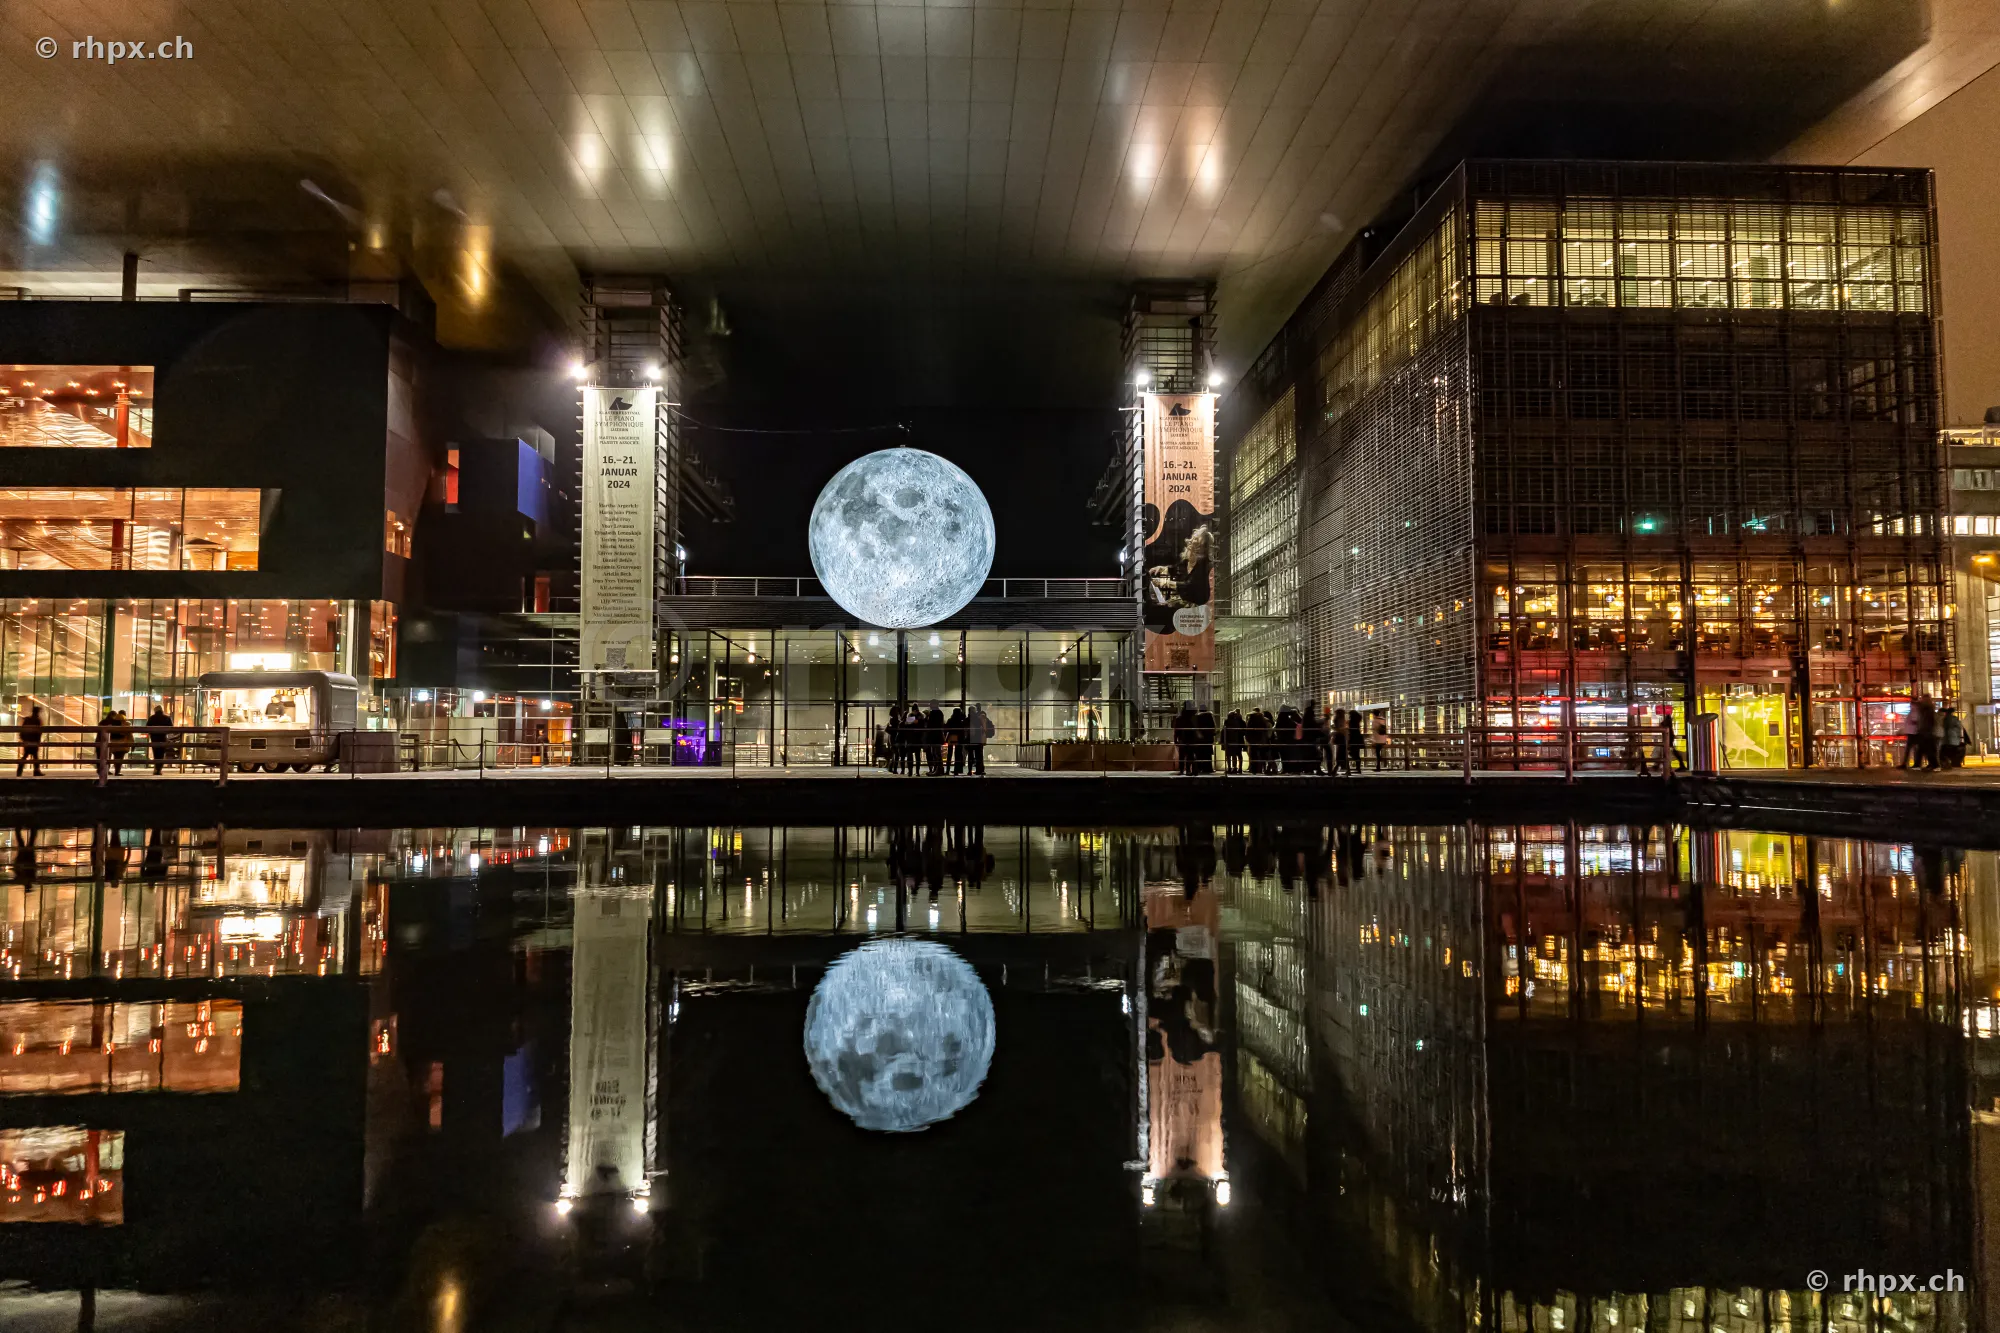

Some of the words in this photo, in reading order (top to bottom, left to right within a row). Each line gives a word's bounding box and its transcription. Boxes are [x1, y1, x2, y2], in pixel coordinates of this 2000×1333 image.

[600, 468, 637, 476] JANUAR
[1161, 473, 1197, 481] JANUAR
[607, 480, 630, 488] 2024
[1168, 485, 1191, 493] 2024
